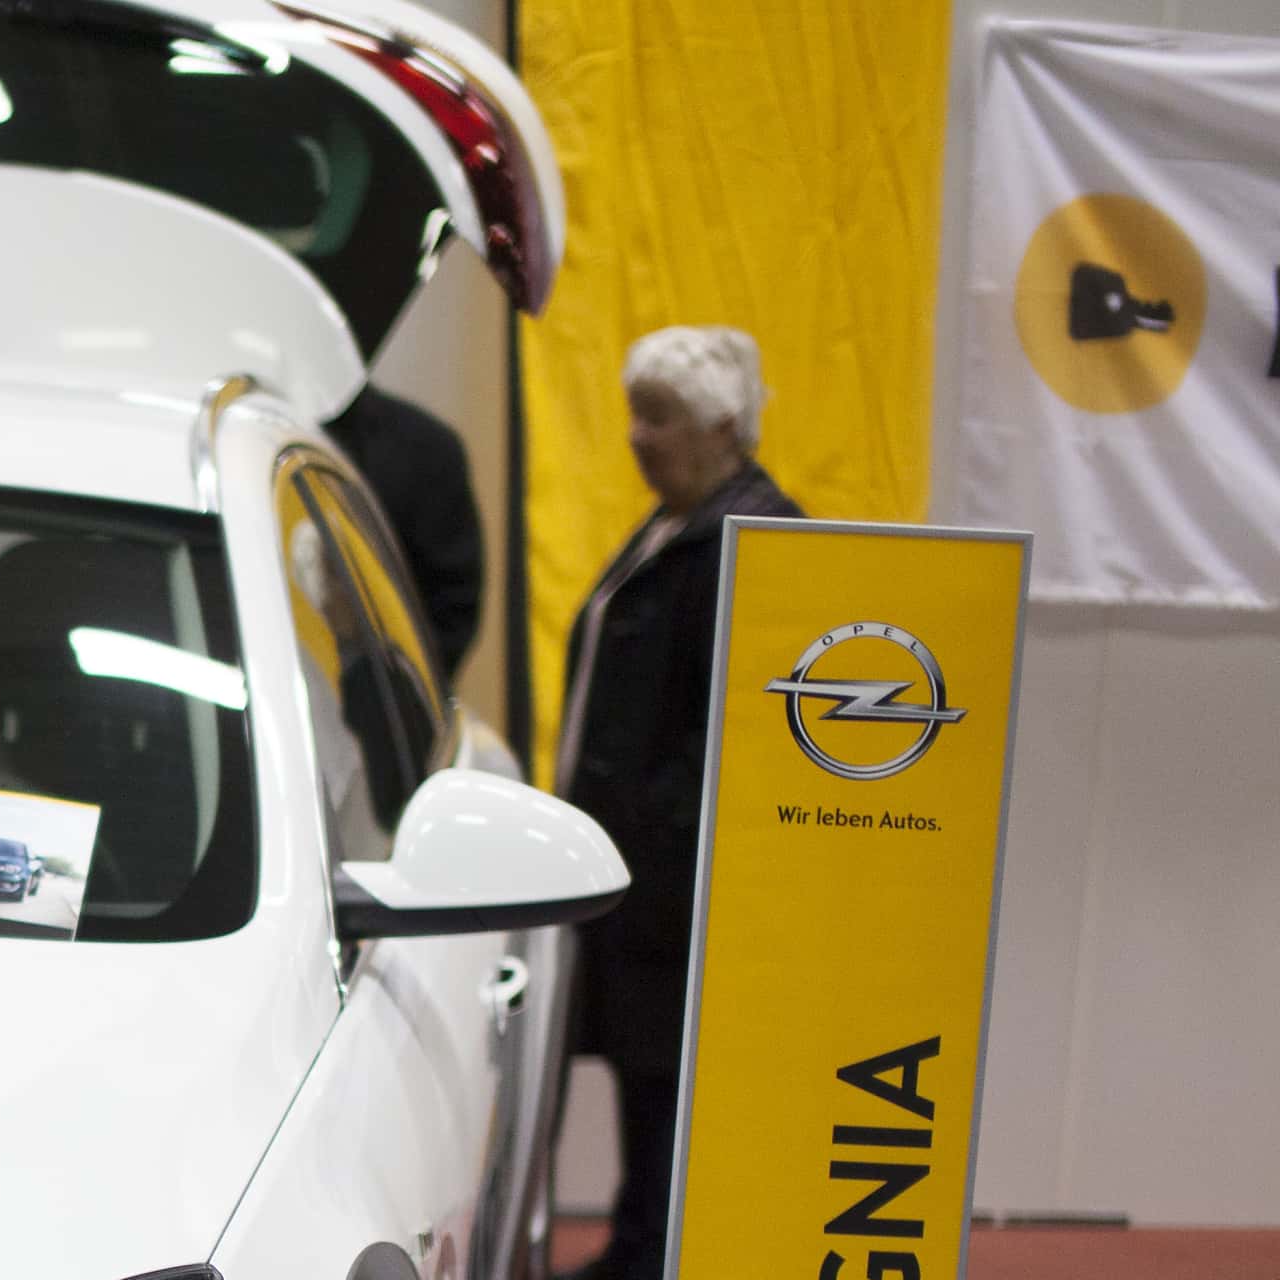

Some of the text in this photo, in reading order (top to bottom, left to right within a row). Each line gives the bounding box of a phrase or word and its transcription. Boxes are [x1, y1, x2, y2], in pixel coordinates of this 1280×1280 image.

[821, 624, 922, 652] OPEL
[777, 805, 942, 831] Wir leben Autos.
